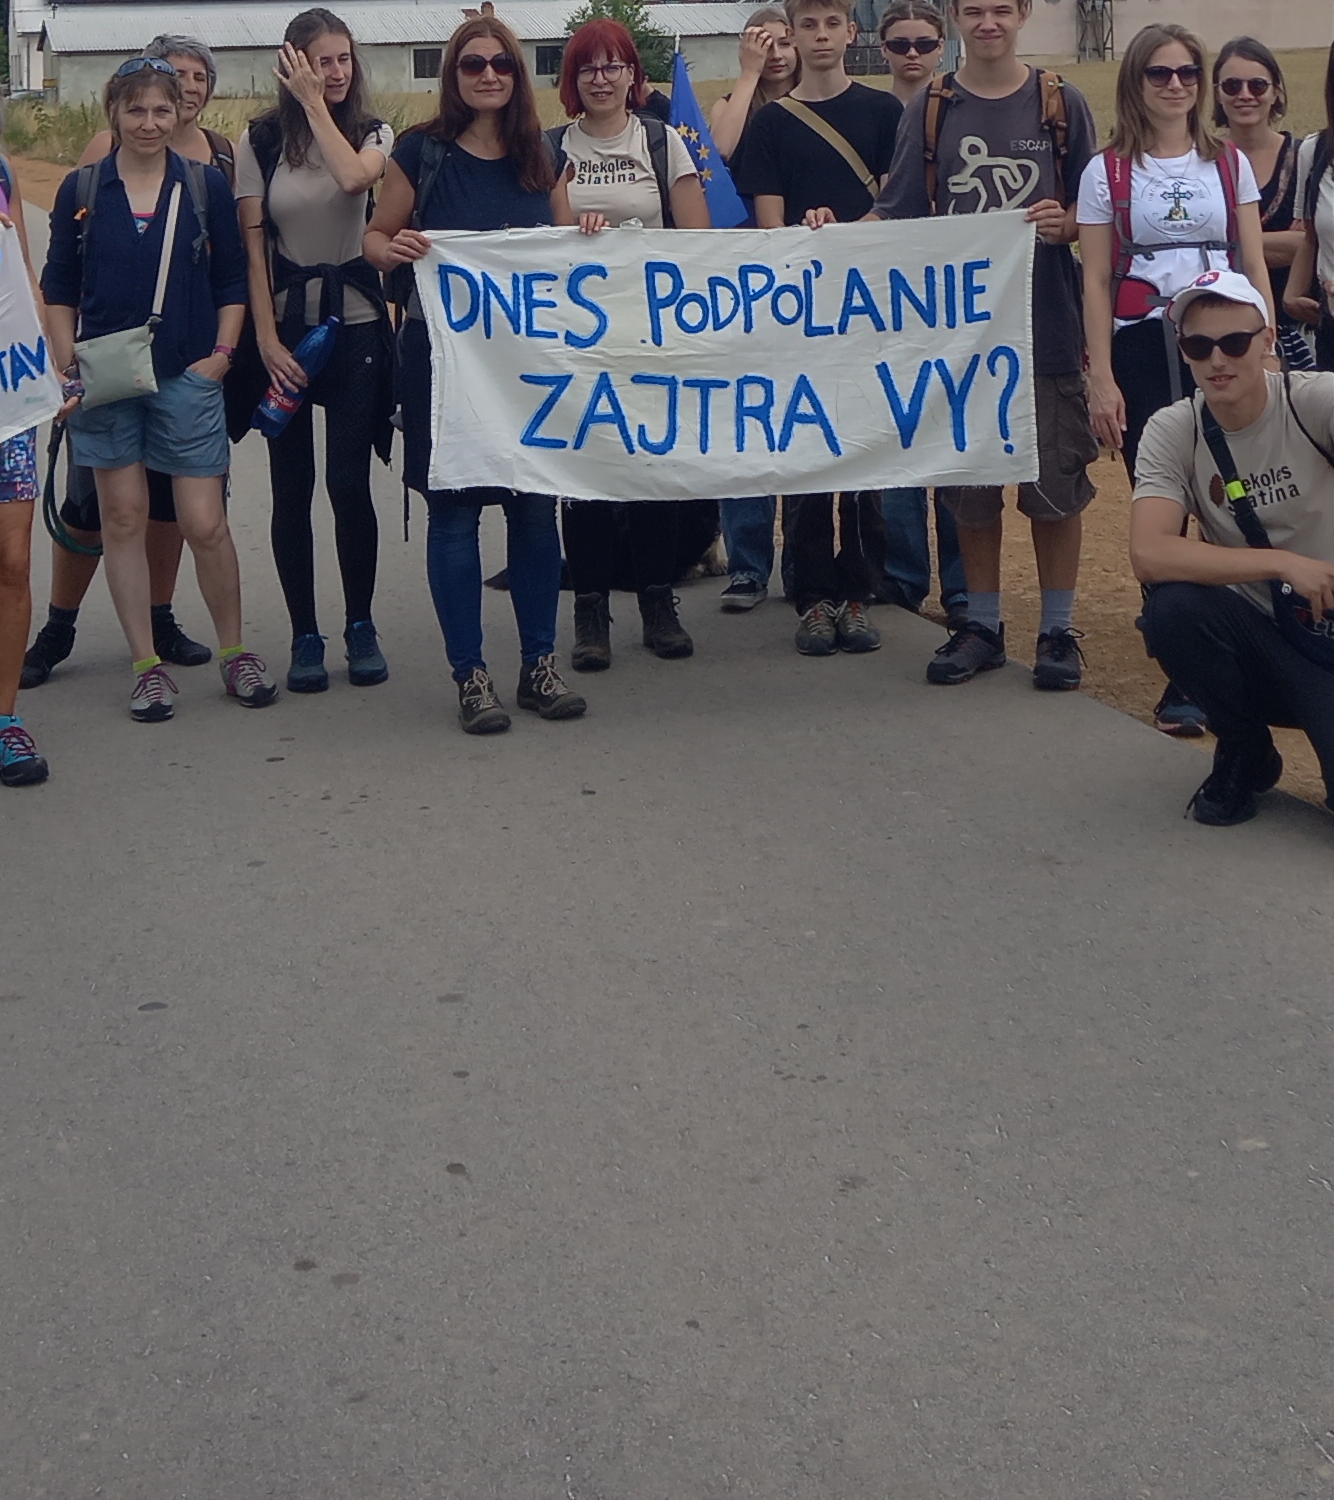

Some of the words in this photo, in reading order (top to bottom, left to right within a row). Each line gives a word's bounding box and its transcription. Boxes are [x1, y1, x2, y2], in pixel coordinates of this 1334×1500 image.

[576, 172, 636, 185] Slatina
[578, 159, 635, 173] Riekoles
[437, 263, 609, 349] DNES
[519, 371, 843, 456] ZAJTRA
[874, 345, 1021, 456] VY?
[1241, 465, 1292, 493] ekoles
